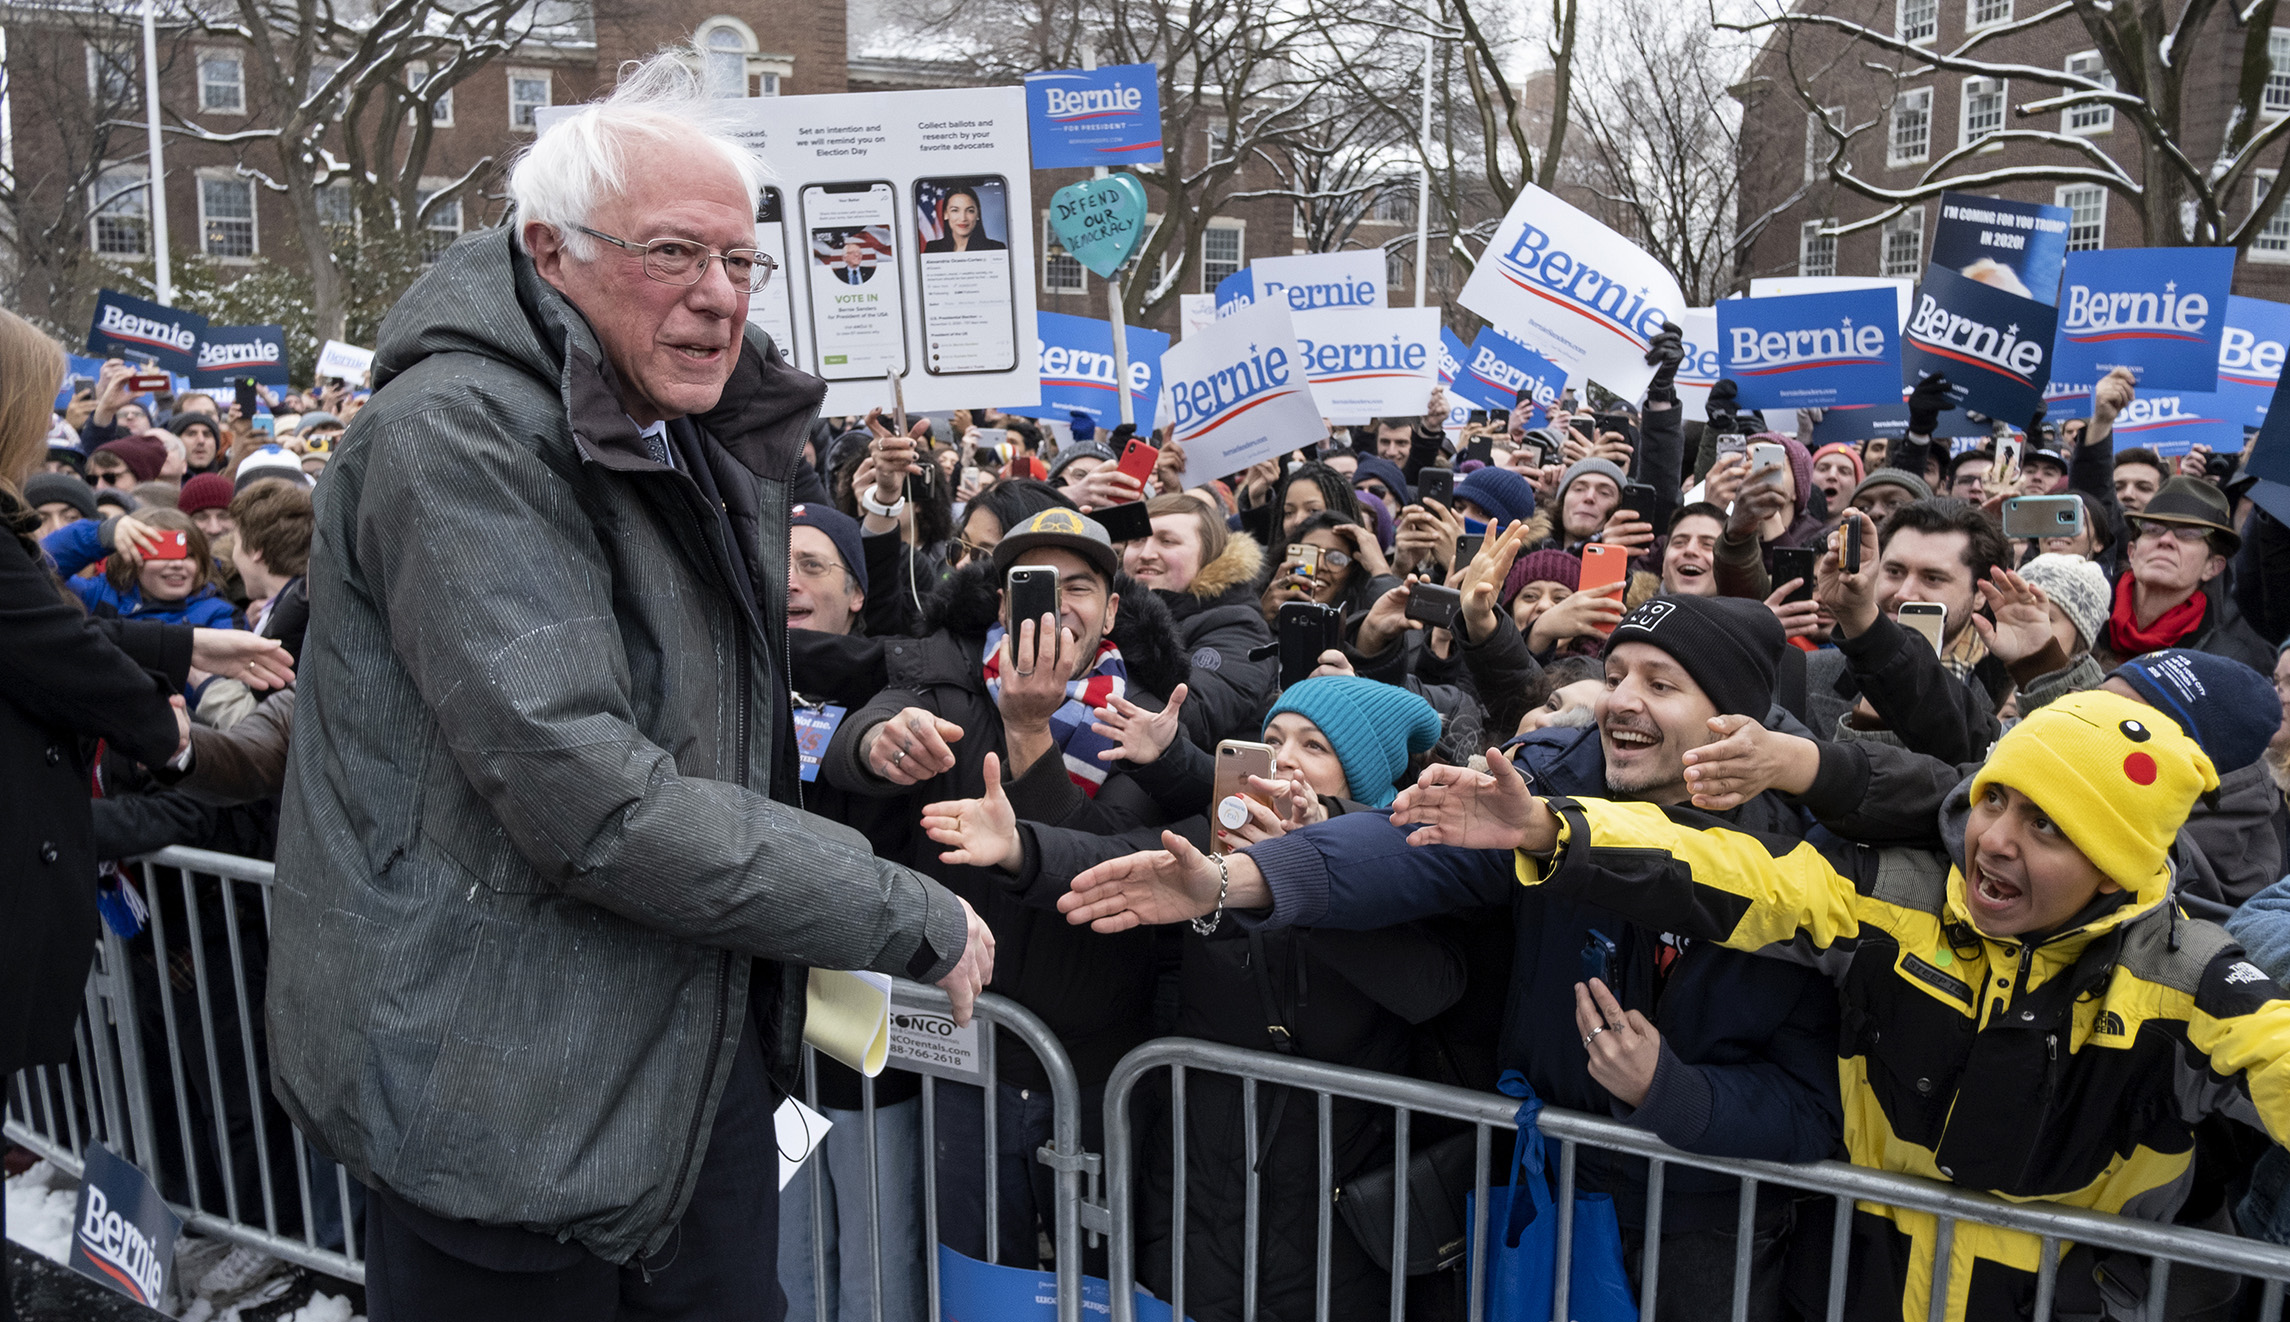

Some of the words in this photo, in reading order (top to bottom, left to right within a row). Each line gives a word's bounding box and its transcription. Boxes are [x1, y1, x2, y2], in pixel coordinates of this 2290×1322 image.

[1045, 81, 1142, 114] Bernie
[798, 127, 812, 135] Set
[826, 124, 863, 134] intention
[865, 124, 881, 132] and
[917, 120, 946, 130] Collect
[948, 119, 975, 128] ballots
[977, 119, 993, 127] and
[922, 132, 957, 140] research
[959, 131, 970, 139] by
[971, 131, 990, 139] your
[1064, 124, 1080, 132] FOR
[1081, 123, 1126, 131] PRESIDENT
[816, 147, 849, 157] Election
[851, 147, 867, 156] Day
[826, 136, 855, 145] remind
[857, 136, 872, 144] you
[919, 142, 951, 152] favorite
[952, 141, 994, 150] advocates
[1056, 189, 1120, 220] DEFEND
[1084, 209, 1119, 228] OUR
[1943, 205, 1959, 220] I'M
[1959, 207, 1996, 225] COMING
[1996, 212, 2015, 227] FOR
[2015, 215, 2034, 230] YOU
[2034, 217, 2067, 234] TRUMP
[1066, 218, 1134, 252] DEMOCRACY
[1980, 230, 1993, 246] IN
[1503, 222, 1668, 341] Bernie
[834, 293, 864, 304] VOTE
[867, 293, 878, 302] IN
[2065, 279, 2209, 330] Bernie
[101, 304, 195, 350] Bernie
[1730, 316, 1885, 364] Bernie
[1911, 293, 2043, 380] Bernie
[197, 338, 280, 364] Bernie
[1298, 333, 1427, 372] Bernie
[1171, 343, 1290, 427] Bernie
[1471, 345, 1555, 406] Bernie
[794, 715, 813, 727] Not
[812, 720, 832, 730] me.
[1908, 960, 1947, 984] STEEP
[890, 1034, 971, 1057] NCOrentals.com
[82, 1183, 162, 1309] Bernie
